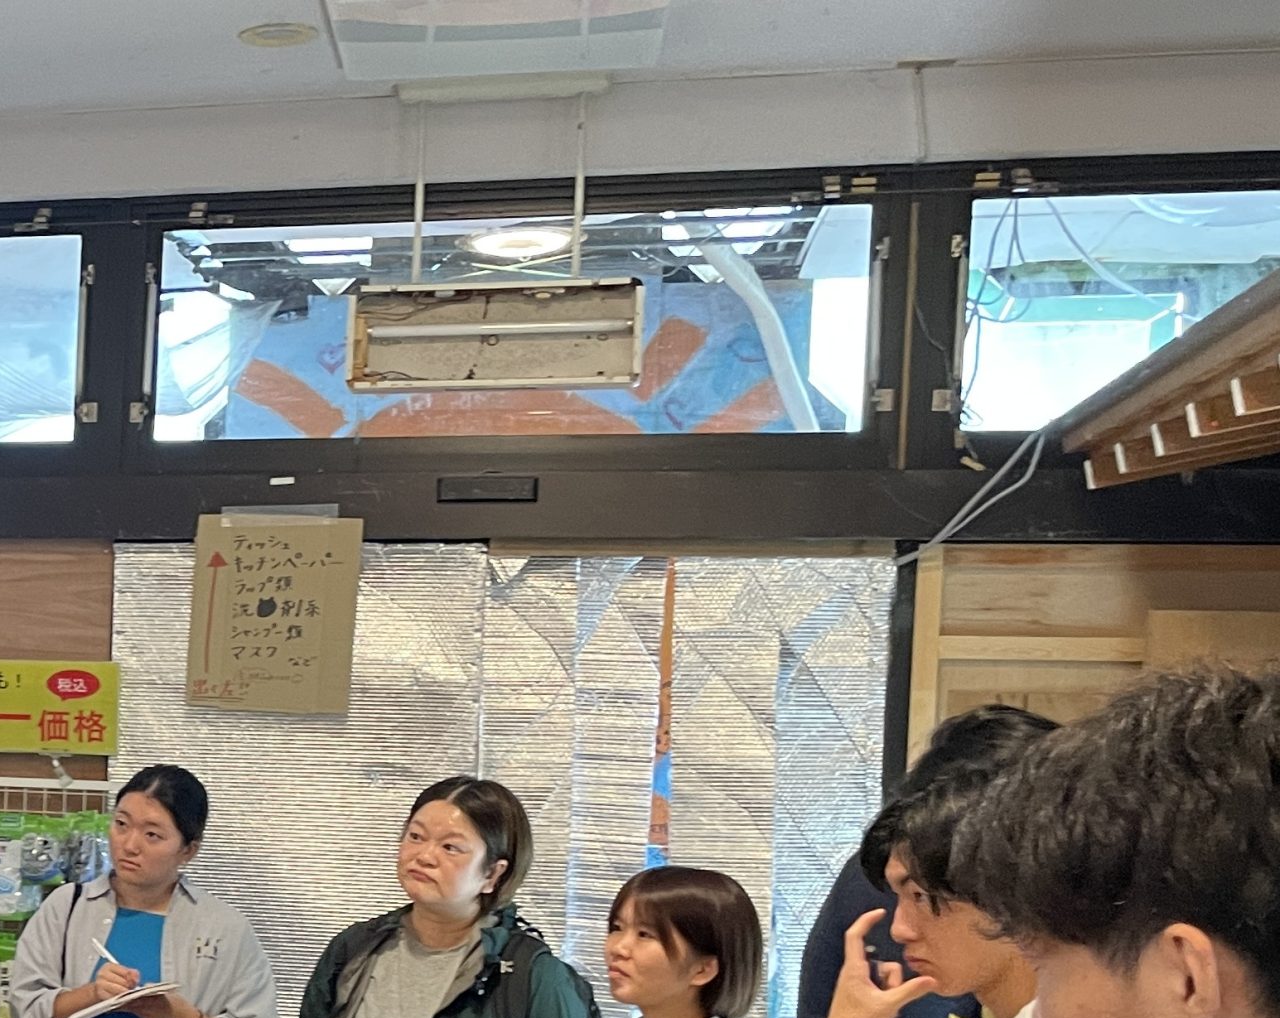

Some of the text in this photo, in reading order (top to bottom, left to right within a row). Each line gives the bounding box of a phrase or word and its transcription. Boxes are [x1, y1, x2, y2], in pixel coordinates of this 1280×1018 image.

[234, 535, 290, 551] ティッシュ
[234, 552, 344, 573] キッチンペーパー
[231, 646, 278, 660] マスク
[288, 656, 318, 667] など
